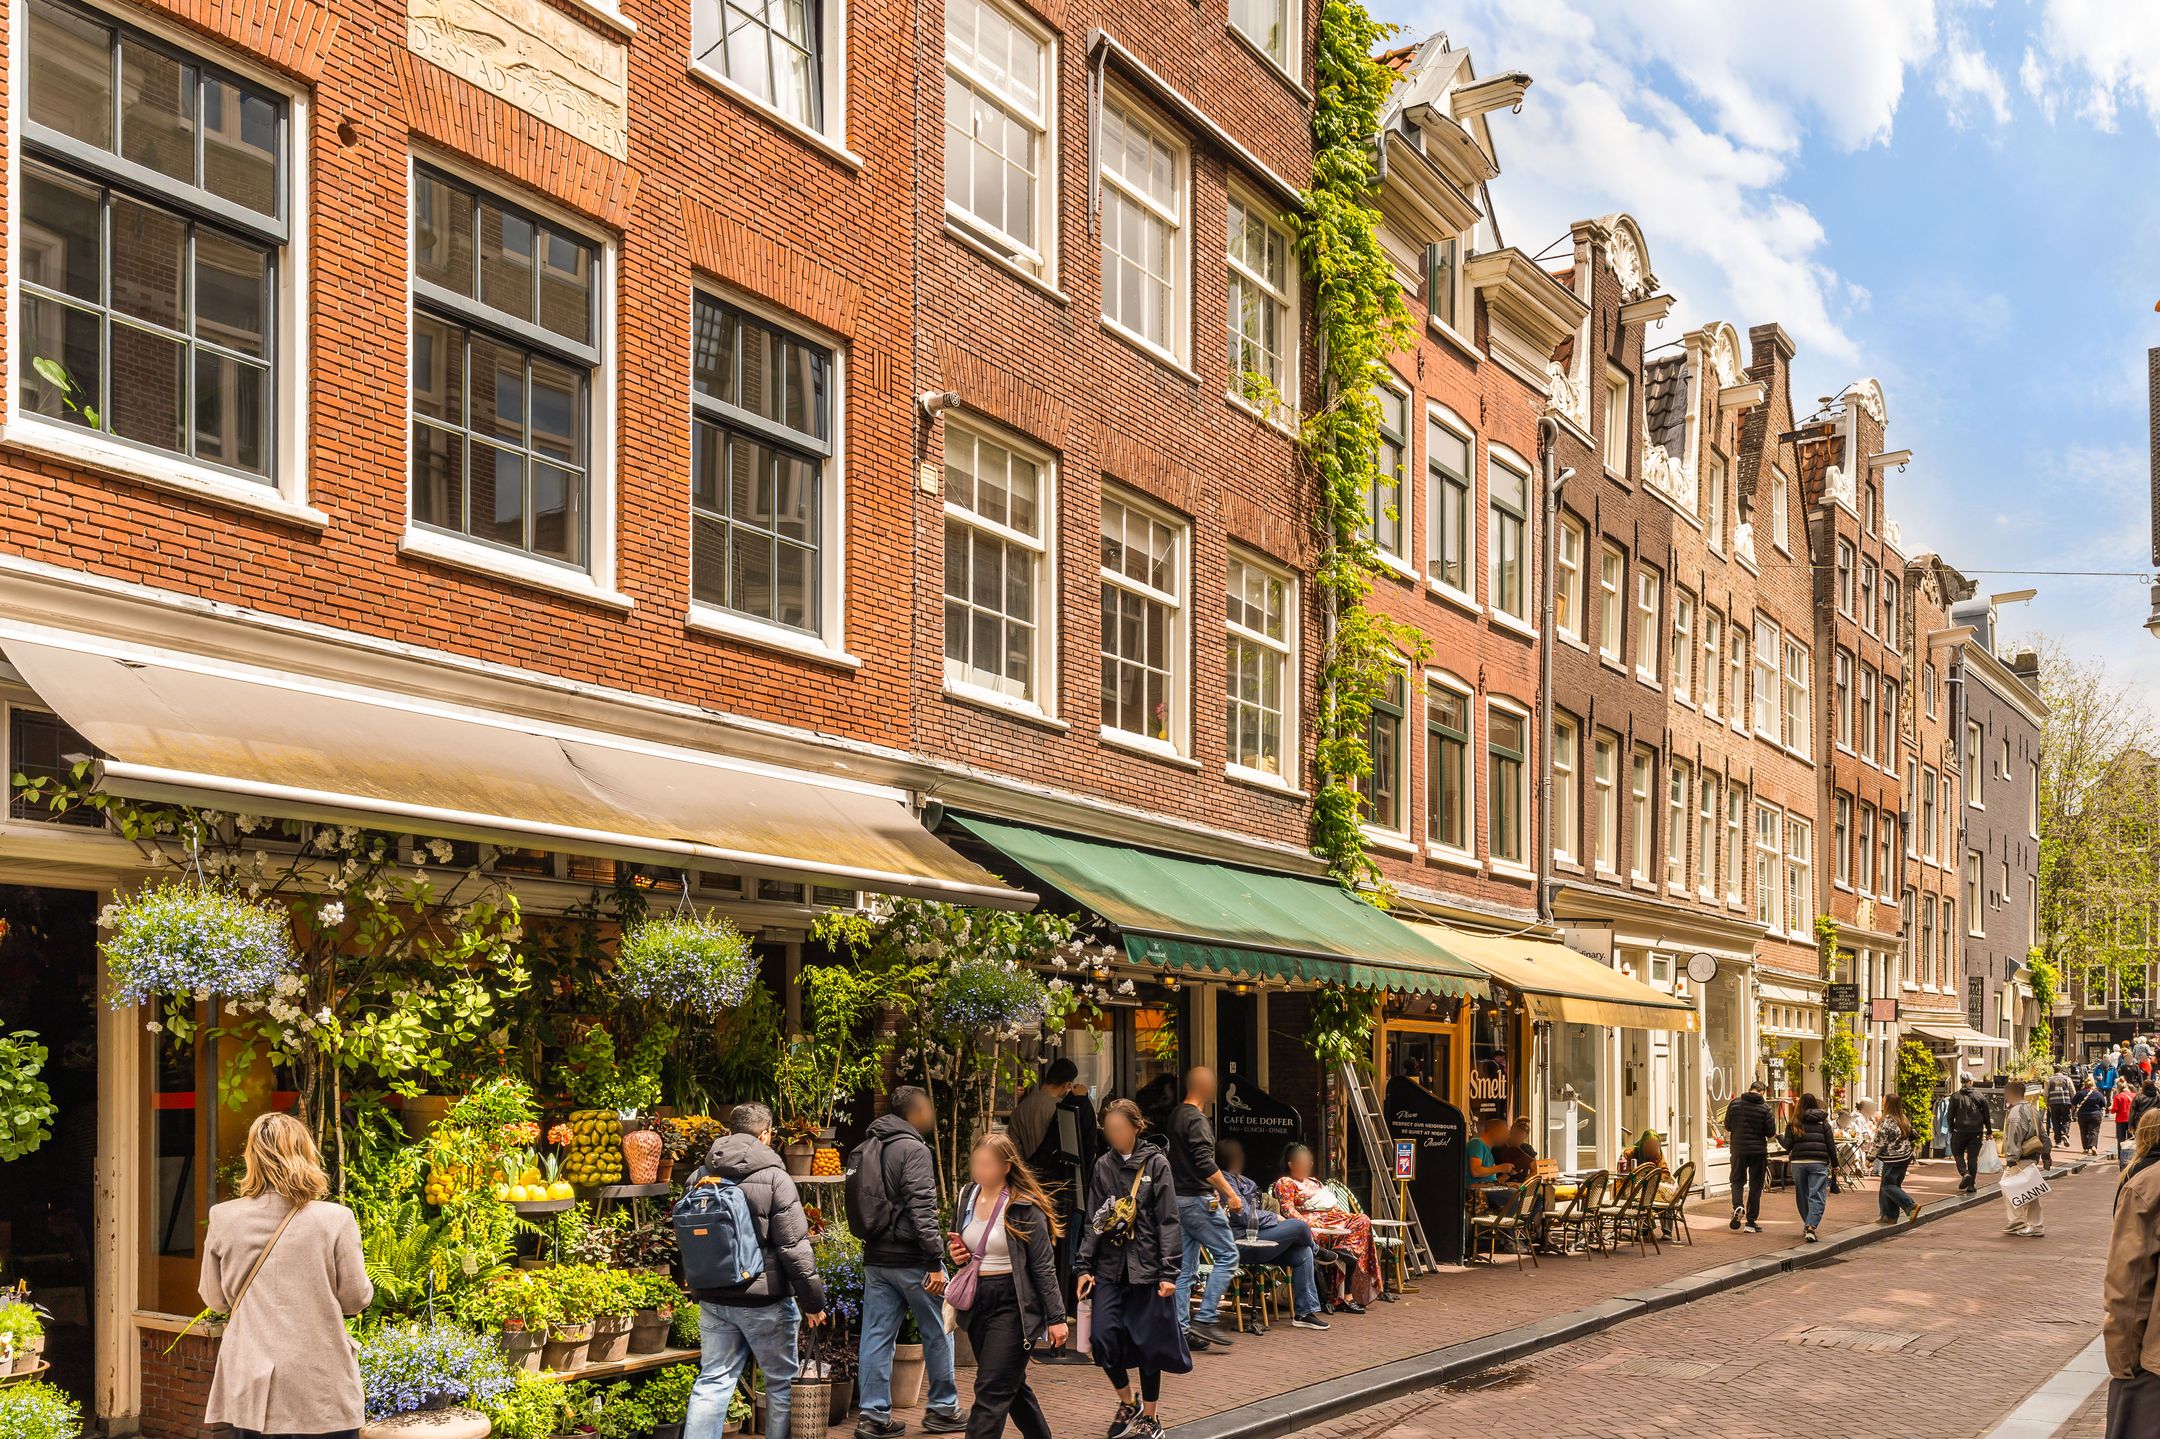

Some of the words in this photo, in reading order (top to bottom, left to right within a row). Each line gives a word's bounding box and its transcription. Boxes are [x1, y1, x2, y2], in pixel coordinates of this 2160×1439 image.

[1808, 1062, 1816, 1073] 6
[1470, 1069, 1507, 1099] Smelt
[1223, 1115, 1245, 1124] CAFÉ
[1246, 1116, 1258, 1125] DE
[1259, 1117, 1294, 1126] DOFFER
[2012, 1182, 2049, 1207] GANNI
